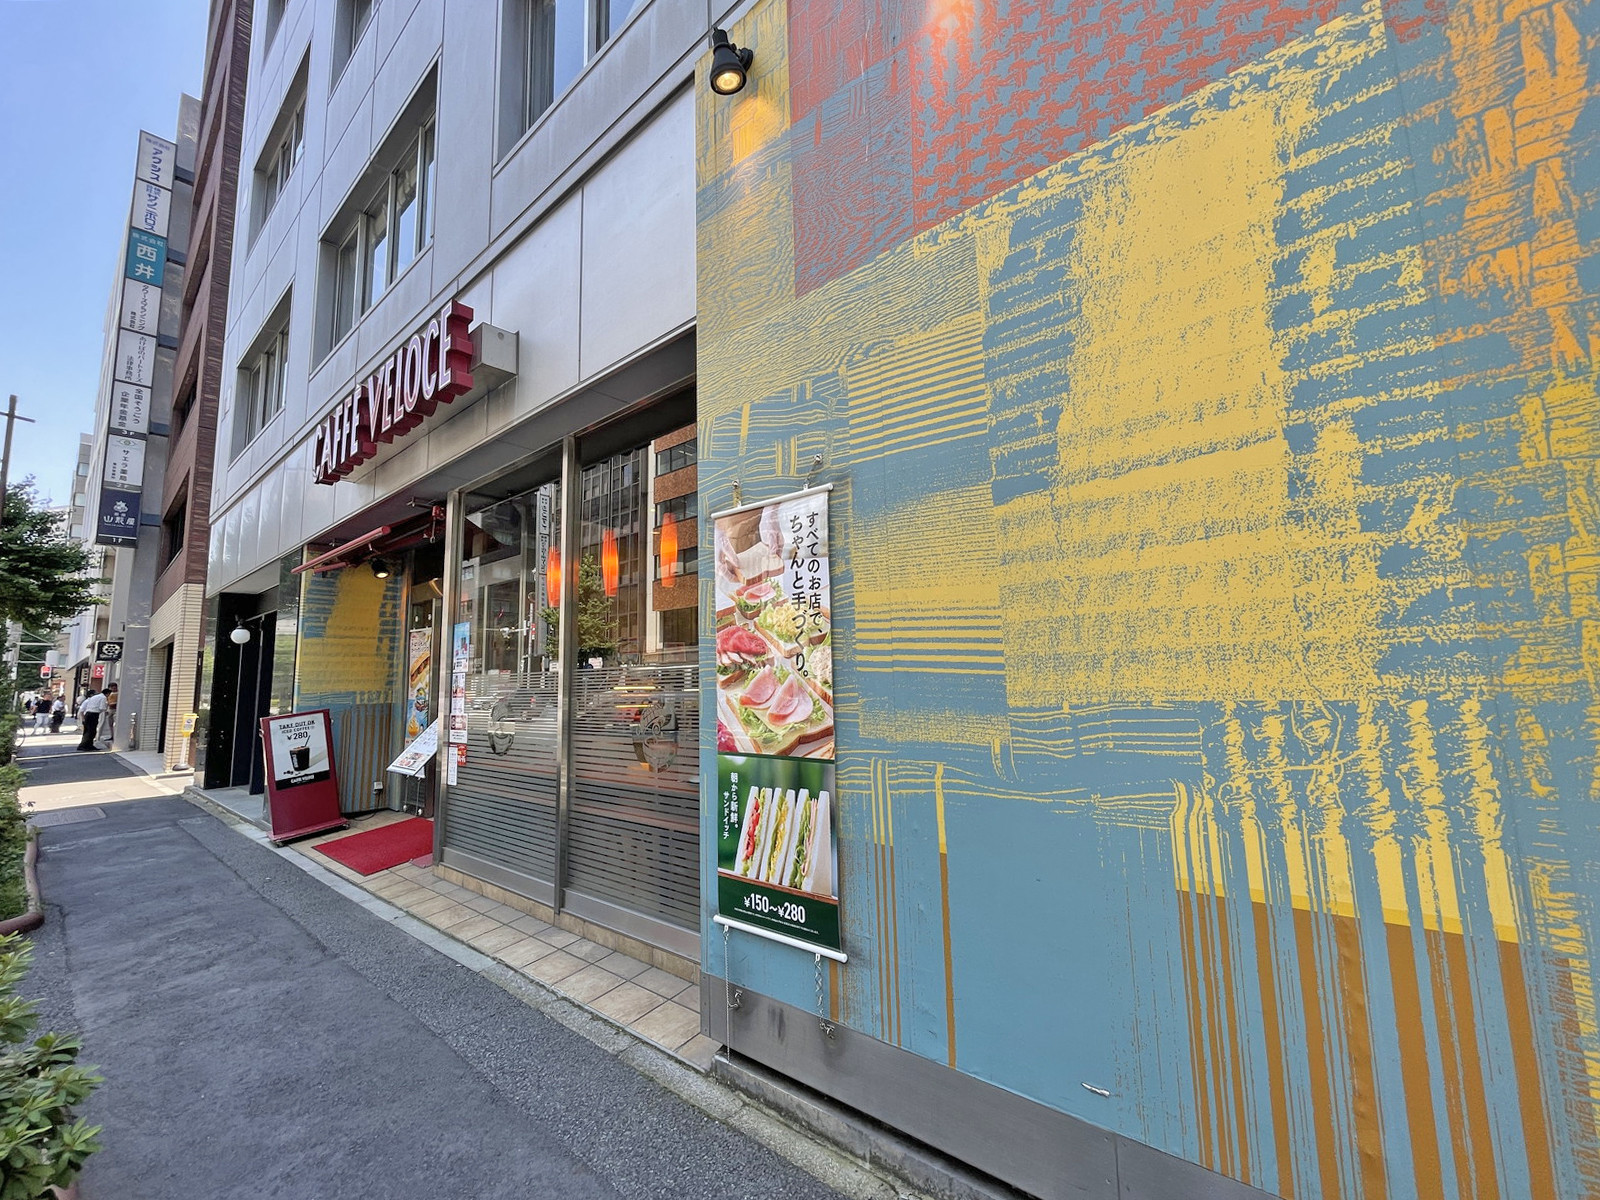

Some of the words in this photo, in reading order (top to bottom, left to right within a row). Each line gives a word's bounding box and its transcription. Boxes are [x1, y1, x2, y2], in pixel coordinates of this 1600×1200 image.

[135, 242, 158, 279] 西井
[367, 300, 453, 443] VELOCE
[119, 449, 130, 481] サエラ薬局
[789, 514, 809, 678] ちゃんと手づくり。
[806, 511, 823, 634] すべてのお店で、
[730, 771, 739, 829] 朝から新鮮。
